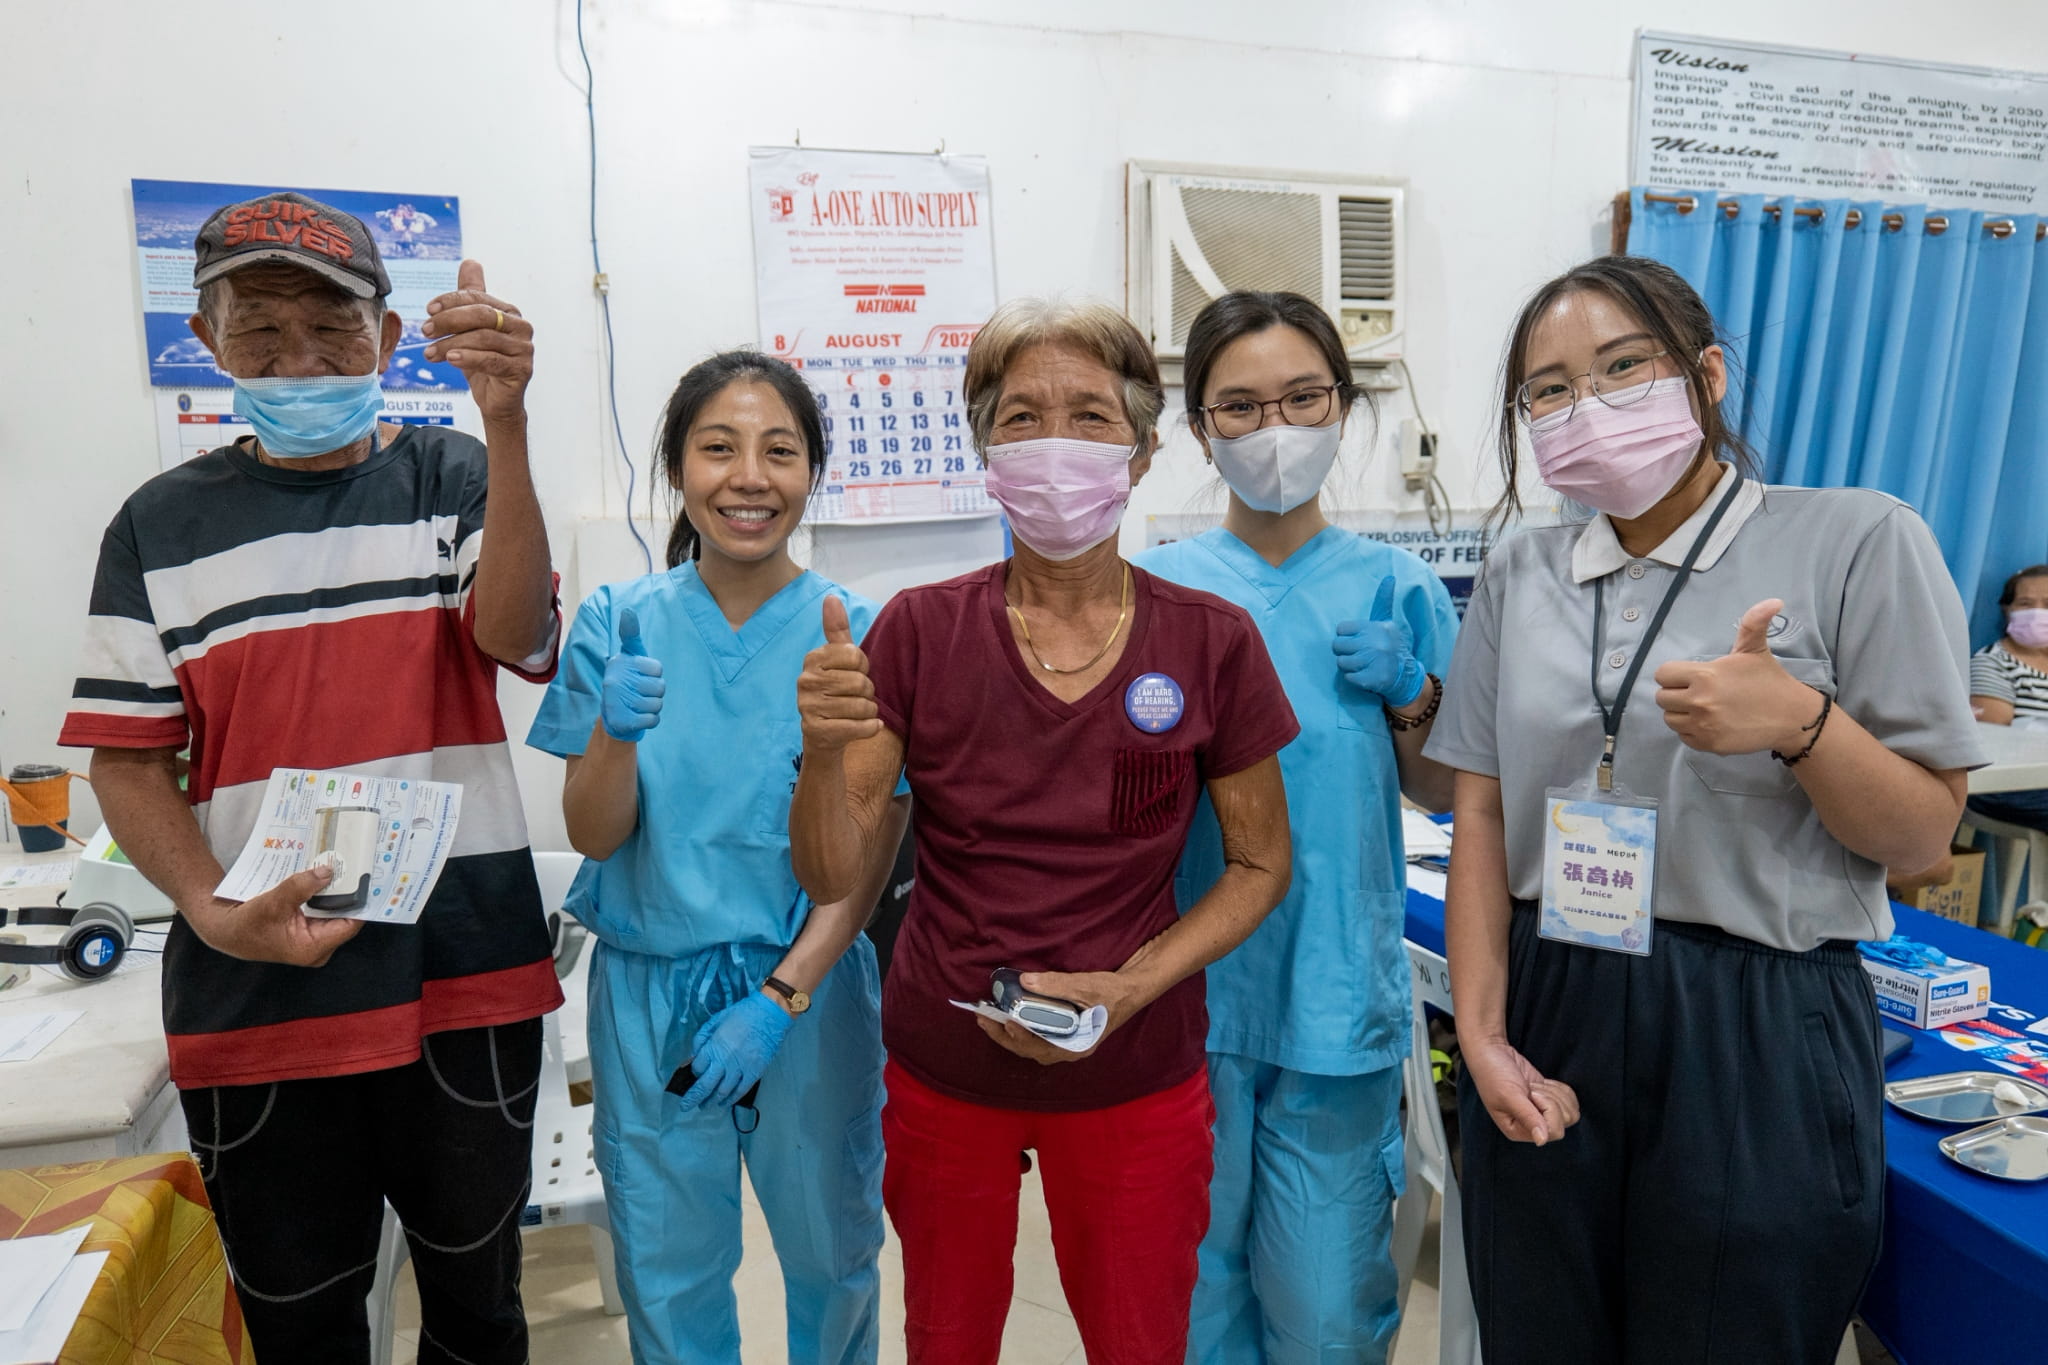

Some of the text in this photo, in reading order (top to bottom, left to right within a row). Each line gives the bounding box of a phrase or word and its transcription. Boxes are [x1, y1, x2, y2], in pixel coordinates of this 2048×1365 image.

[1650, 49, 1749, 73] Vision
[1655, 69, 2043, 118] Imploring the aid of the almighty, by 2030
[1654, 81, 1680, 92] the
[1686, 84, 1722, 95] PNP
[1750, 90, 1784, 102] Civil
[1789, 95, 1851, 110] Security
[1860, 102, 1907, 116] Group
[1918, 108, 1952, 119] shall
[1962, 113, 1979, 122] be
[2003, 116, 2048, 130] Highly
[1654, 94, 1724, 109] capable,
[1735, 102, 1802, 115] effective
[1807, 108, 1834, 120] and
[1839, 112, 1899, 125] credible
[1904, 118, 1970, 132] firearms,
[1651, 118, 1718, 132] towards
[1728, 126, 1738, 134] a
[1749, 128, 1804, 141] secure,
[1815, 133, 1868, 147] orderly
[1878, 140, 1905, 150] and
[1916, 143, 1949, 153] safe
[1653, 107, 1685, 117] and
[1701, 110, 1756, 122] private
[1772, 117, 1831, 132] security
[1840, 123, 1914, 138] industries
[1929, 132, 2003, 148] regulatory
[1650, 136, 1780, 160] Mission
[1650, 175, 1731, 189] industries.
[1652, 153, 1669, 163] To
[1680, 156, 1754, 170] efficiently
[1764, 163, 1792, 173] and
[1801, 167, 1877, 180] effectively
[1969, 180, 2037, 194] regulatory
[1650, 166, 1716, 178] services
[1721, 171, 1741, 179] on
[1746, 171, 1812, 185] firearms,
[1816, 177, 1894, 193] explosives
[1929, 188, 1977, 199] private
[1982, 191, 2034, 204] security
[869, 191, 914, 226] AUTO
[918, 191, 979, 227] SUPPLY
[224, 220, 354, 260] SILVER
[856, 299, 917, 313] NATIONAL
[775, 335, 785, 350] 8
[826, 333, 902, 348] AUGUST
[807, 356, 955, 368] MON TUE WED THU FRI
[386, 401, 453, 411] GUST 2026
[850, 393, 861, 409] 4
[882, 391, 893, 408] 5
[913, 391, 924, 407] 6
[944, 390, 953, 406] 7
[848, 416, 864, 431] 11
[880, 414, 897, 431] 12
[911, 413, 929, 430] 13
[942, 413, 960, 428] 14
[849, 438, 867, 454] 18
[880, 437, 899, 453] 19
[911, 436, 932, 452] 20
[944, 435, 962, 451] 21
[849, 460, 870, 477] 25
[881, 459, 902, 476] 26
[914, 458, 932, 474] 27
[944, 456, 965, 473] 28
[1420, 547, 1445, 563] OF
[1134, 697, 1143, 705] OF
[1142, 688, 1152, 696] AM
[1154, 688, 1173, 697] HARD
[1580, 887, 1613, 899] Janice
[1885, 979, 1919, 997] Nitrile
[1932, 984, 1965, 999] Sure-Guard
[1877, 999, 1913, 1017] Sure-Gu
[1930, 1007, 1951, 1017] Nitrile
[1952, 1004, 1974, 1013] Gloves
